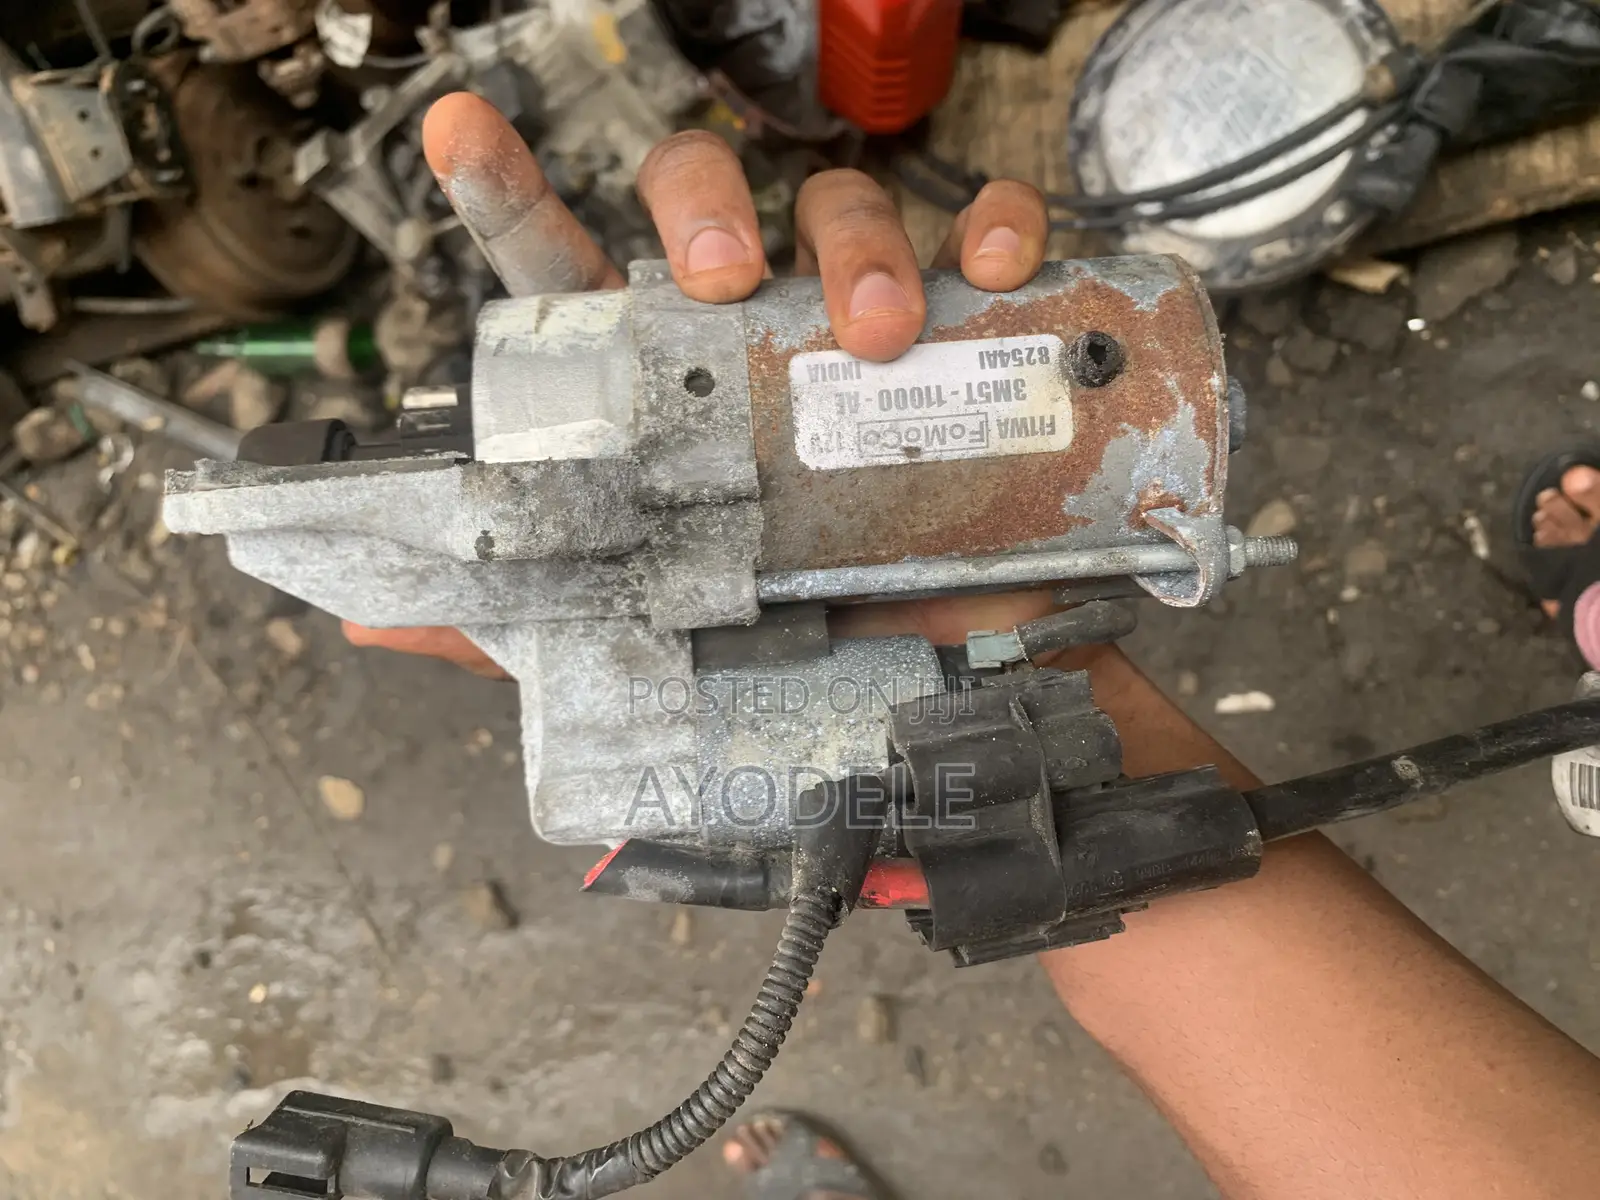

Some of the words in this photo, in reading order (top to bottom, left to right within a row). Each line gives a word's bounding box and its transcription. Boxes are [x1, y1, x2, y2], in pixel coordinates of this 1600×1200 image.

[806, 360, 862, 382] INDIA
[878, 384, 948, 412] 11000
[965, 378, 1027, 406] 3M5T
[862, 420, 986, 449] FoMoCo
